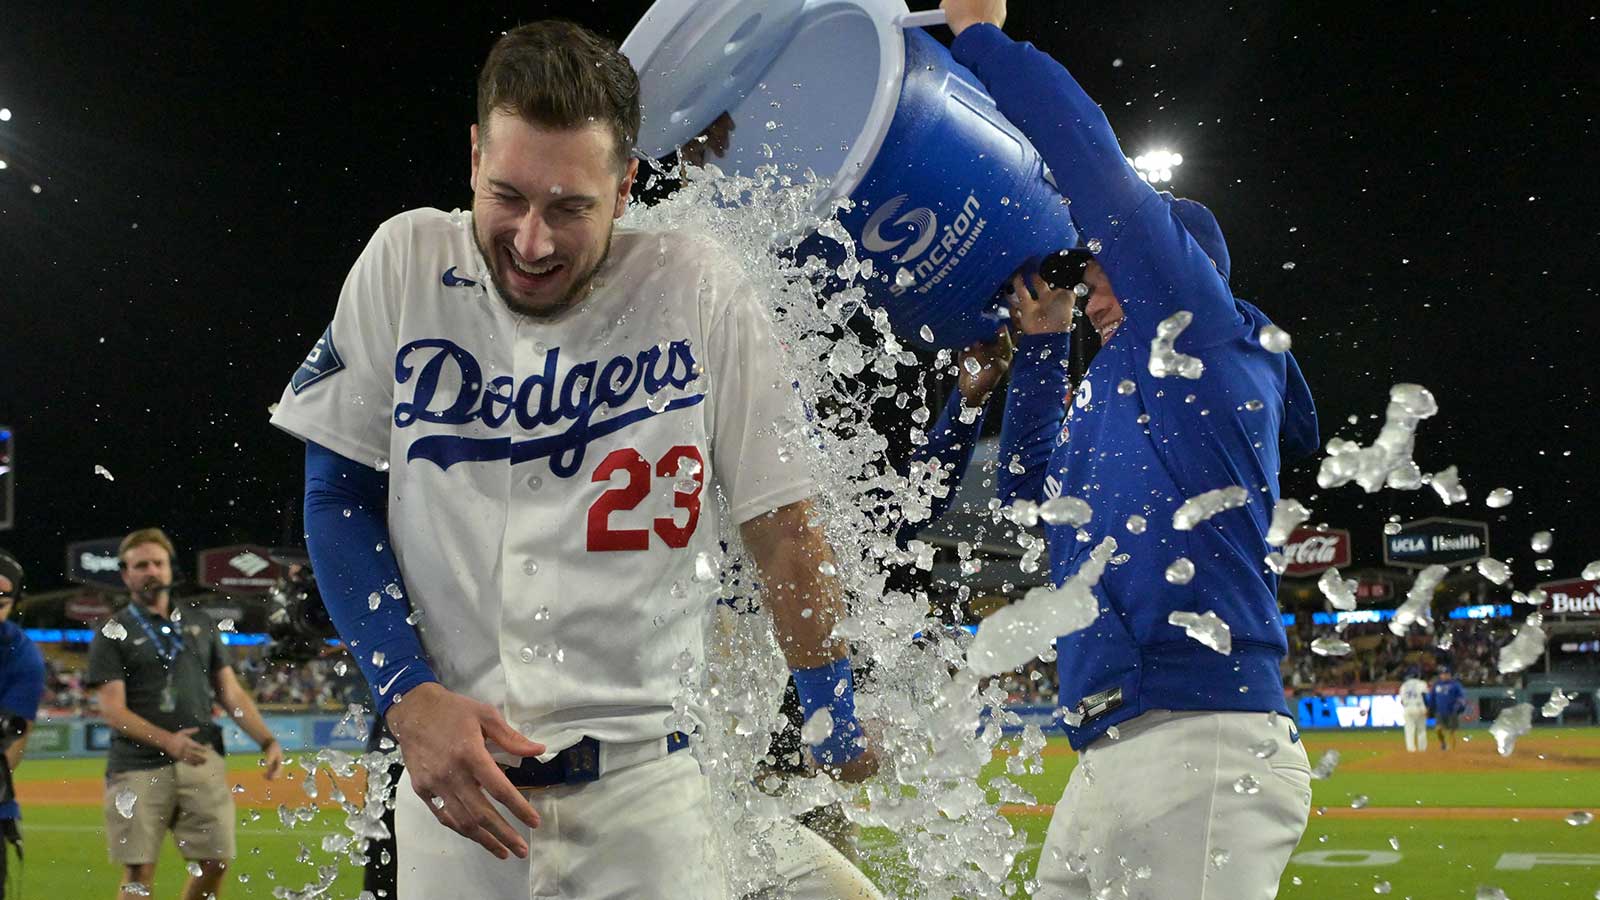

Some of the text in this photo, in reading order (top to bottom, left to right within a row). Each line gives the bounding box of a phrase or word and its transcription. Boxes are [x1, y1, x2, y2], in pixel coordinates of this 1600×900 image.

[918, 217, 987, 294] SPORTS DRINK
[395, 338, 700, 479] Dodgers
[586, 445, 705, 553] 23
[1391, 533, 1480, 553] UCLA Health
